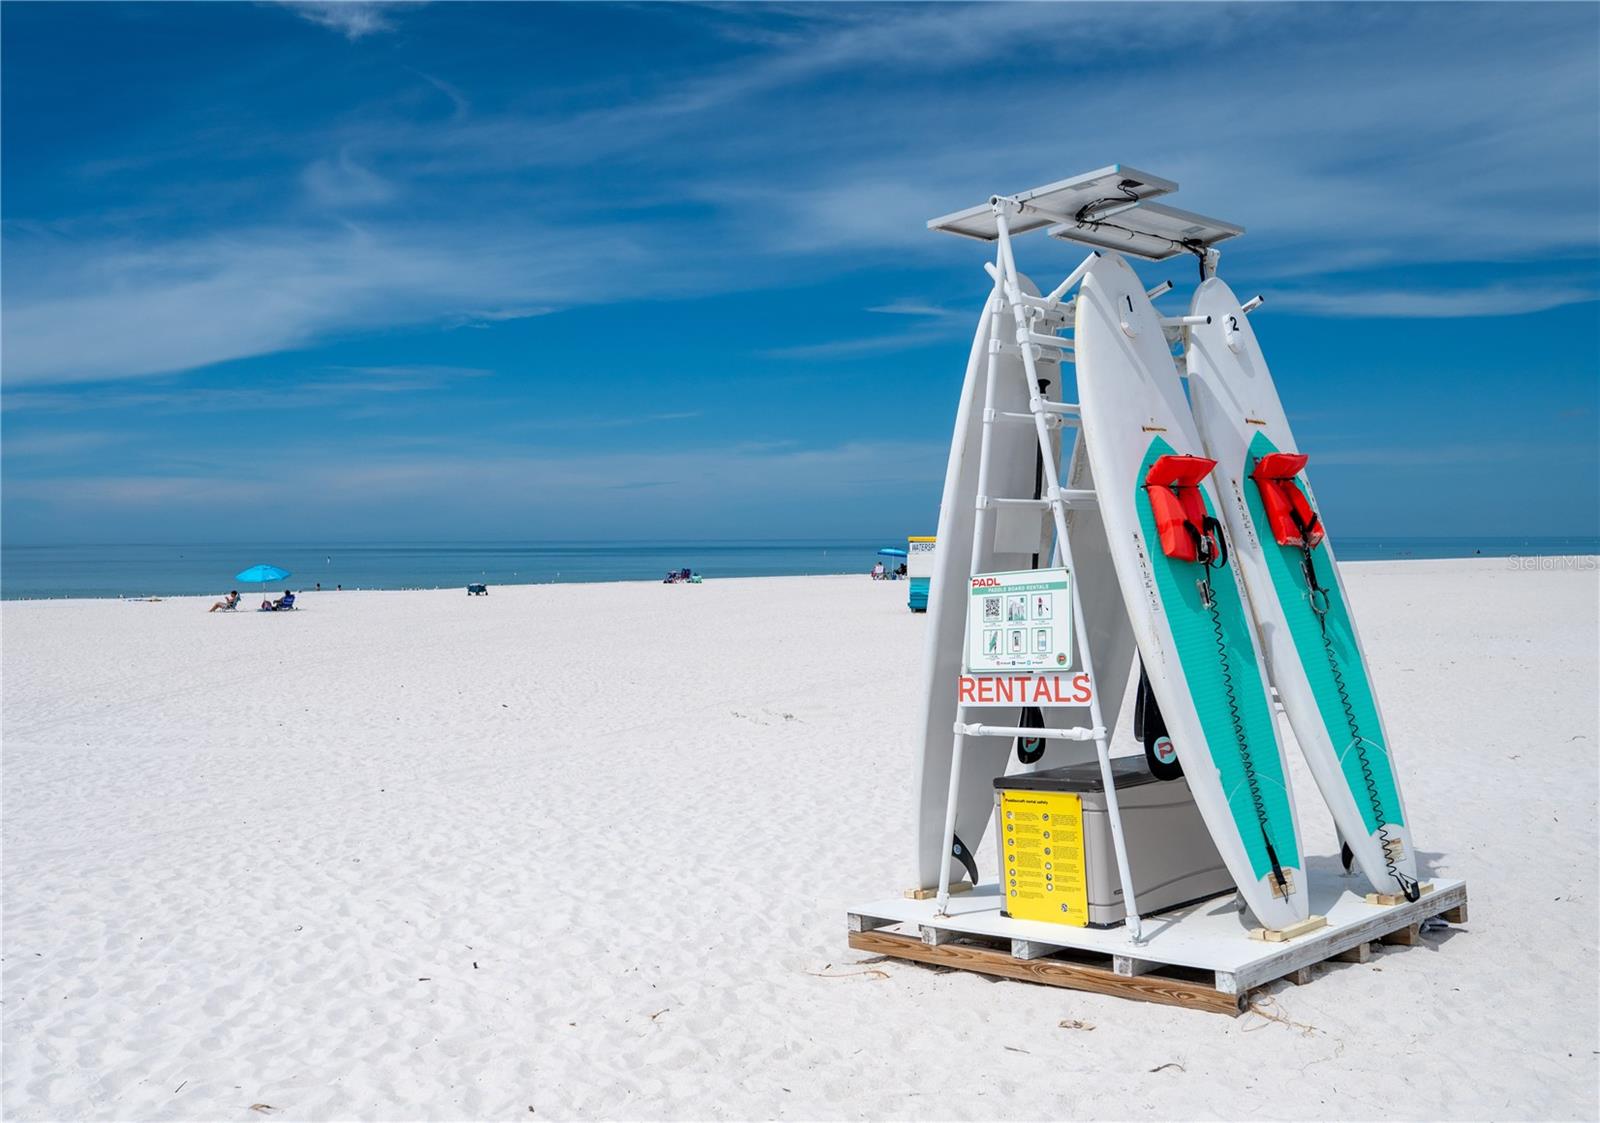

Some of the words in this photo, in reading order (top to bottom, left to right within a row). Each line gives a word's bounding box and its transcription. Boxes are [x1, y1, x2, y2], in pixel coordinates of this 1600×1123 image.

[1126, 295, 1133, 312] 1
[1229, 316, 1239, 332] 2
[911, 543, 936, 552] WATERSP
[972, 577, 1001, 588] PADL
[1008, 584, 1025, 592] BOARD
[1026, 583, 1049, 591] RENTALS
[959, 676, 1092, 703] RENTALS
